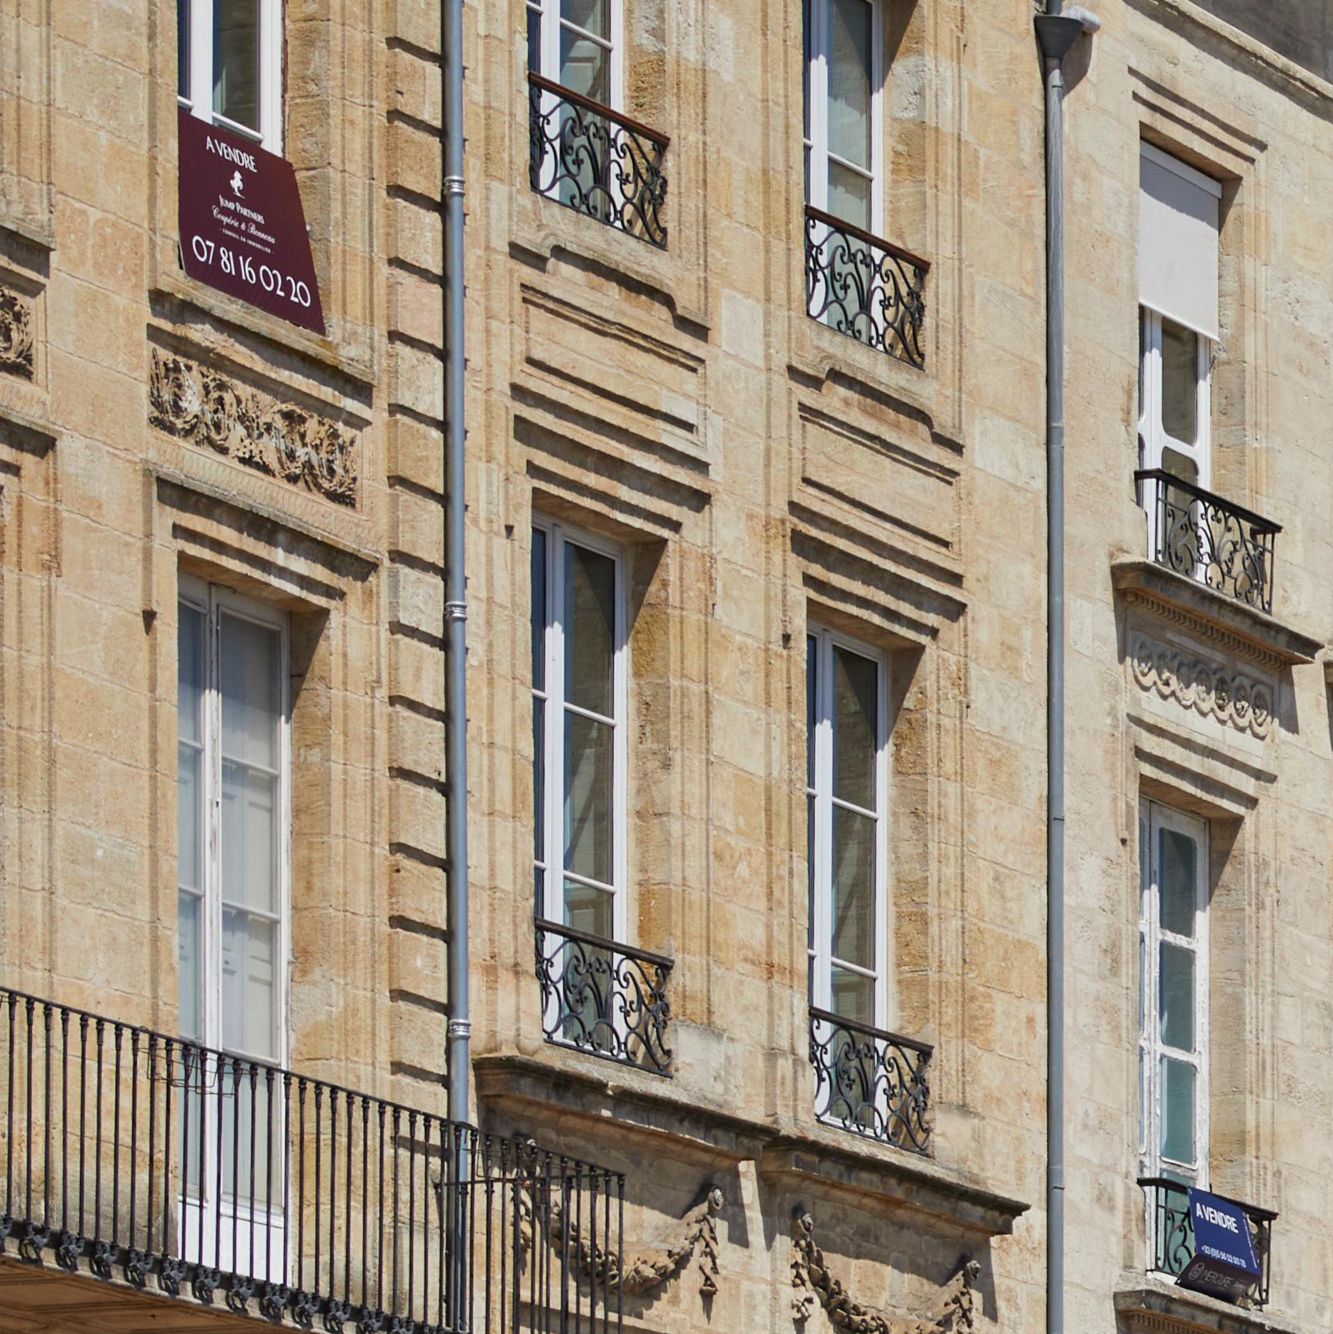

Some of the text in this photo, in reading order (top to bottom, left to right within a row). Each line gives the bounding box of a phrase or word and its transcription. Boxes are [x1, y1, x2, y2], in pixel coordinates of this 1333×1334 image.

[206, 136, 257, 173] A VENDRE
[236, 201, 265, 225] PARTNERS
[192, 235, 311, 307] 07 81 16 02 20
[1196, 1203, 1239, 1233] A VENDRE
